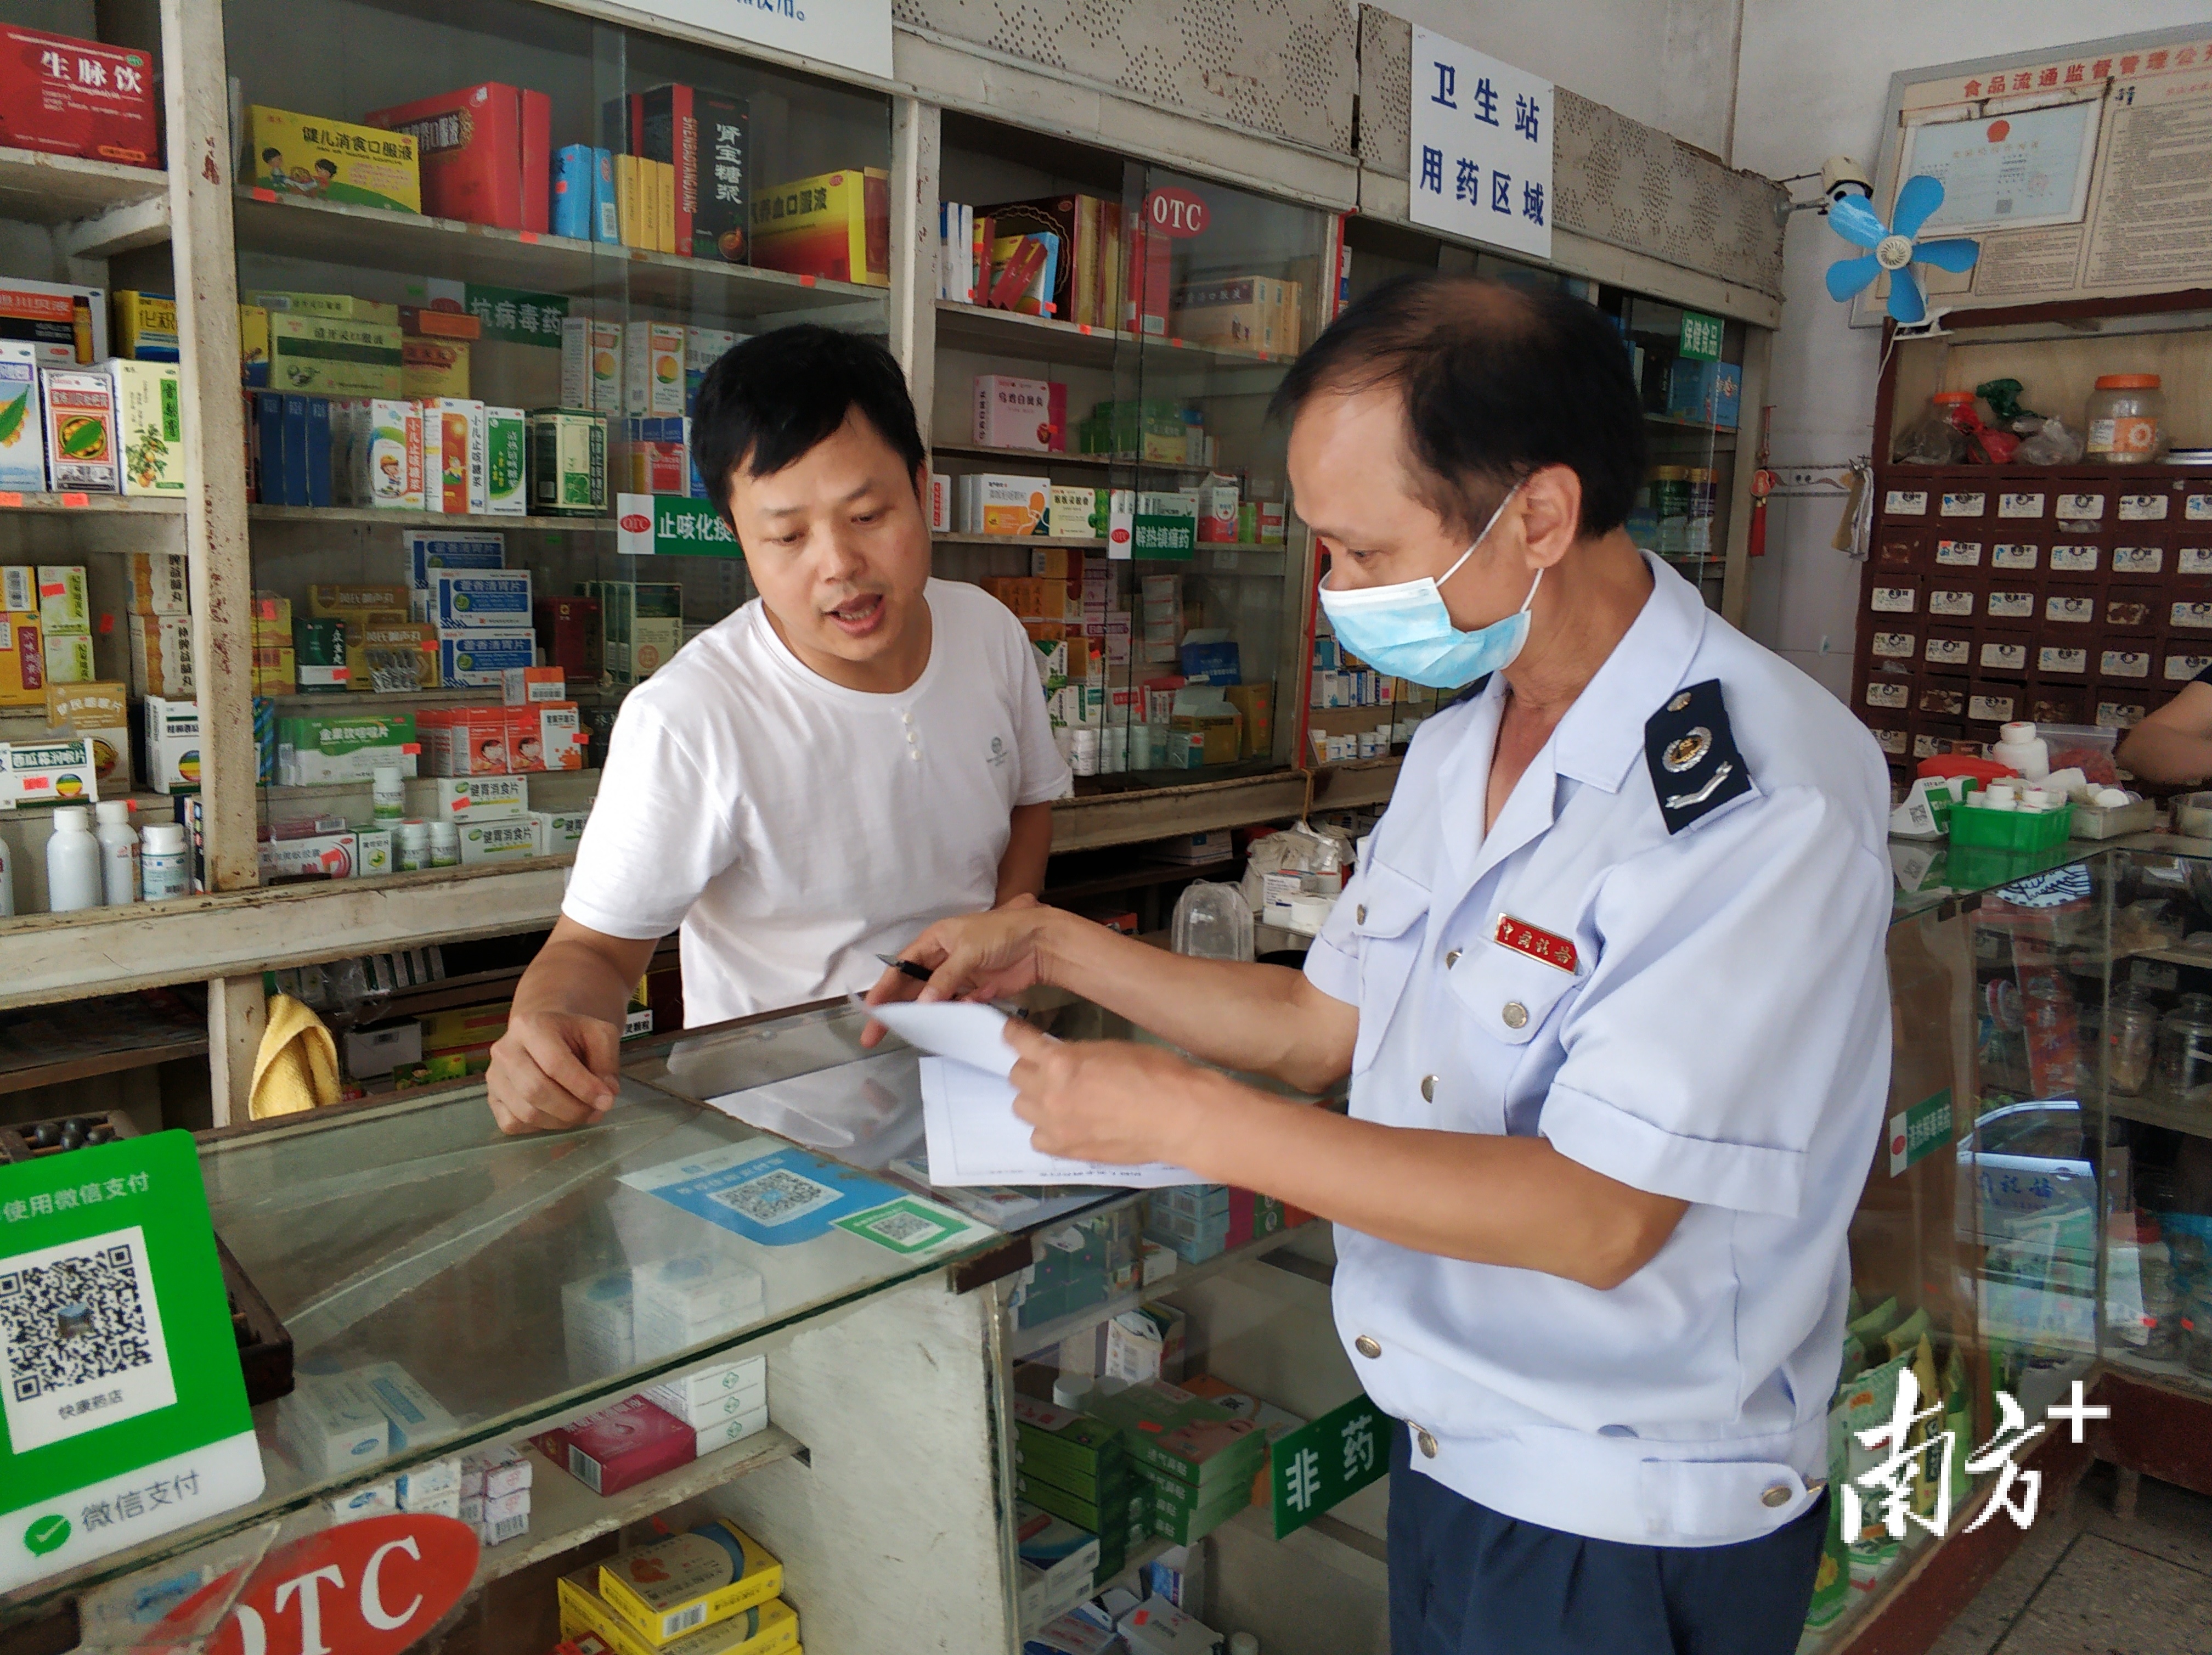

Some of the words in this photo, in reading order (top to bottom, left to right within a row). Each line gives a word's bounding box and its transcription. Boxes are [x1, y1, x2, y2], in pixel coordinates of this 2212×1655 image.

[41, 51, 143, 94] 生脉饮
[1431, 61, 1540, 143] 卫生站
[302, 126, 413, 161] 健儿消食口服液
[682, 116, 697, 213] SHENBAOTANGJIANG
[715, 123, 742, 204] 肾宝糖浆
[1420, 145, 1544, 226] 用药区域
[1153, 195, 1202, 231] OTC
[471, 297, 562, 336] 抗病毒药
[1683, 318, 1718, 356] 保健食品
[998, 391, 1043, 407] 乌鸡白凤丸
[623, 517, 648, 530] OTC
[657, 511, 736, 543] 止咳化痰
[1135, 525, 1190, 549] 解热镇痛药
[331, 629, 345, 665] 众生丸
[2, 1170, 150, 1223] 使用微信支付
[58, 1389, 123, 1420] 快康药店
[1285, 1414, 1374, 1513] 非药
[81, 1468, 200, 1532] 微信支付
